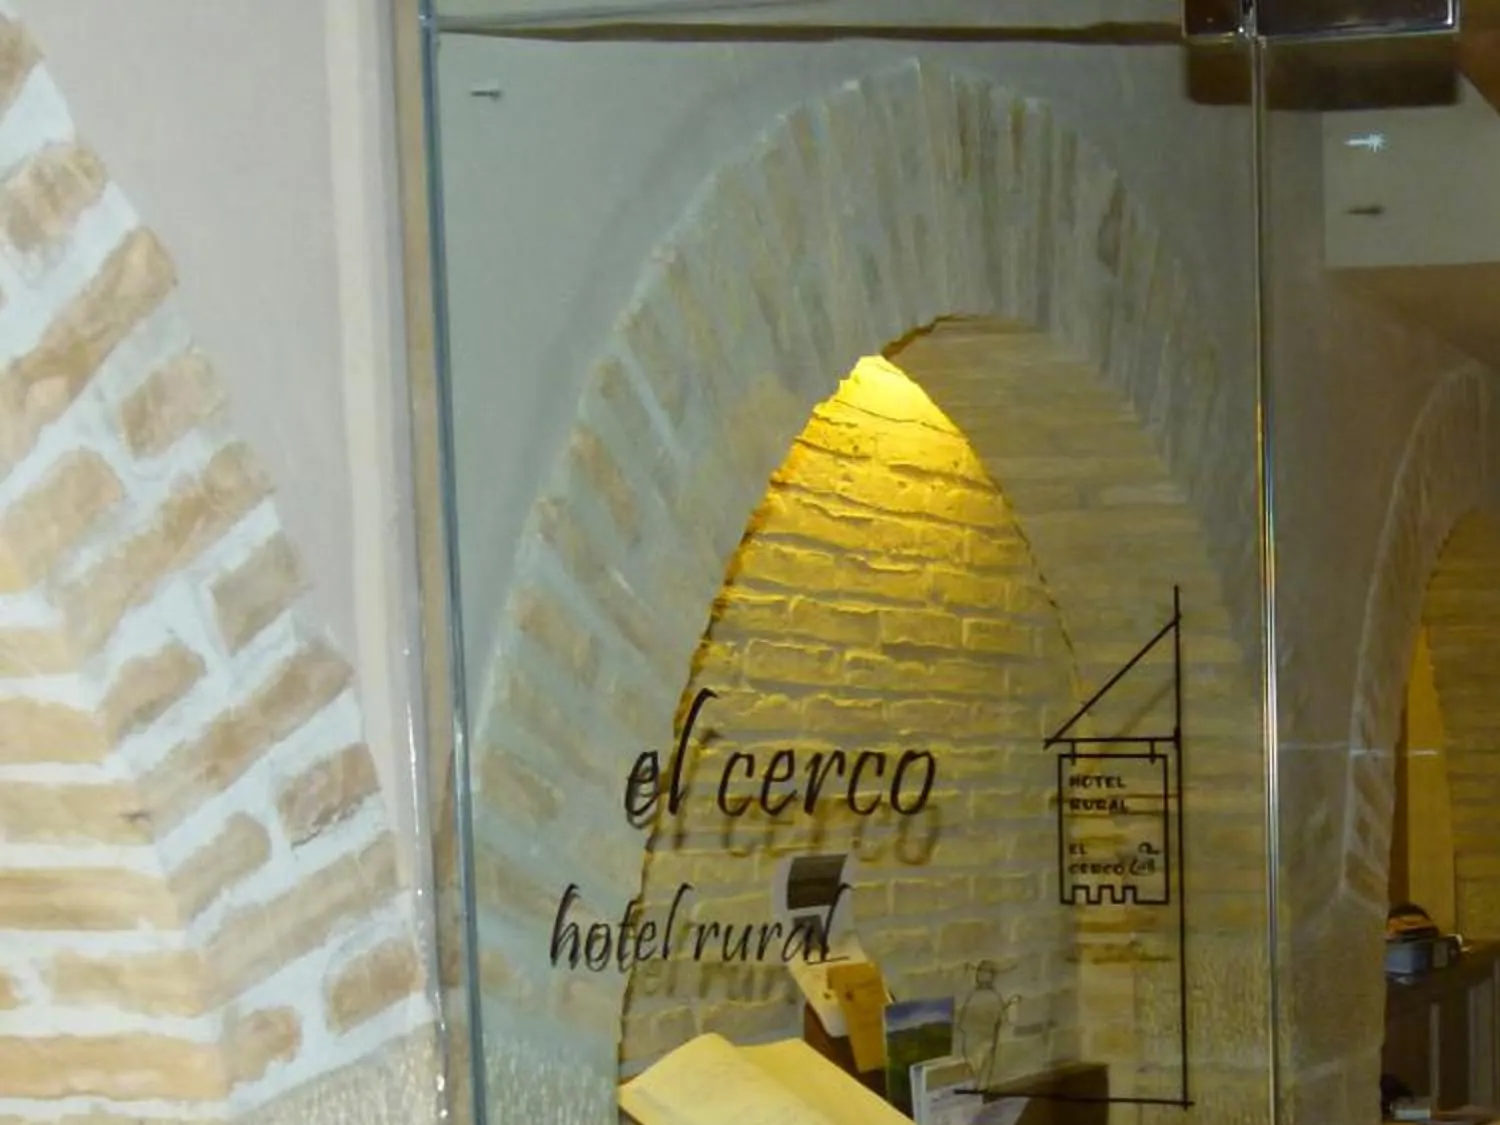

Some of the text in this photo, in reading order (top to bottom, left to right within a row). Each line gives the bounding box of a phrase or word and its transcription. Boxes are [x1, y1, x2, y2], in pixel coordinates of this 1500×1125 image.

[624, 687, 937, 820] el cerco
[1069, 775, 1126, 789] HOTEL
[1069, 798, 1128, 812] RURAL
[550, 883, 852, 971] hotel rural
